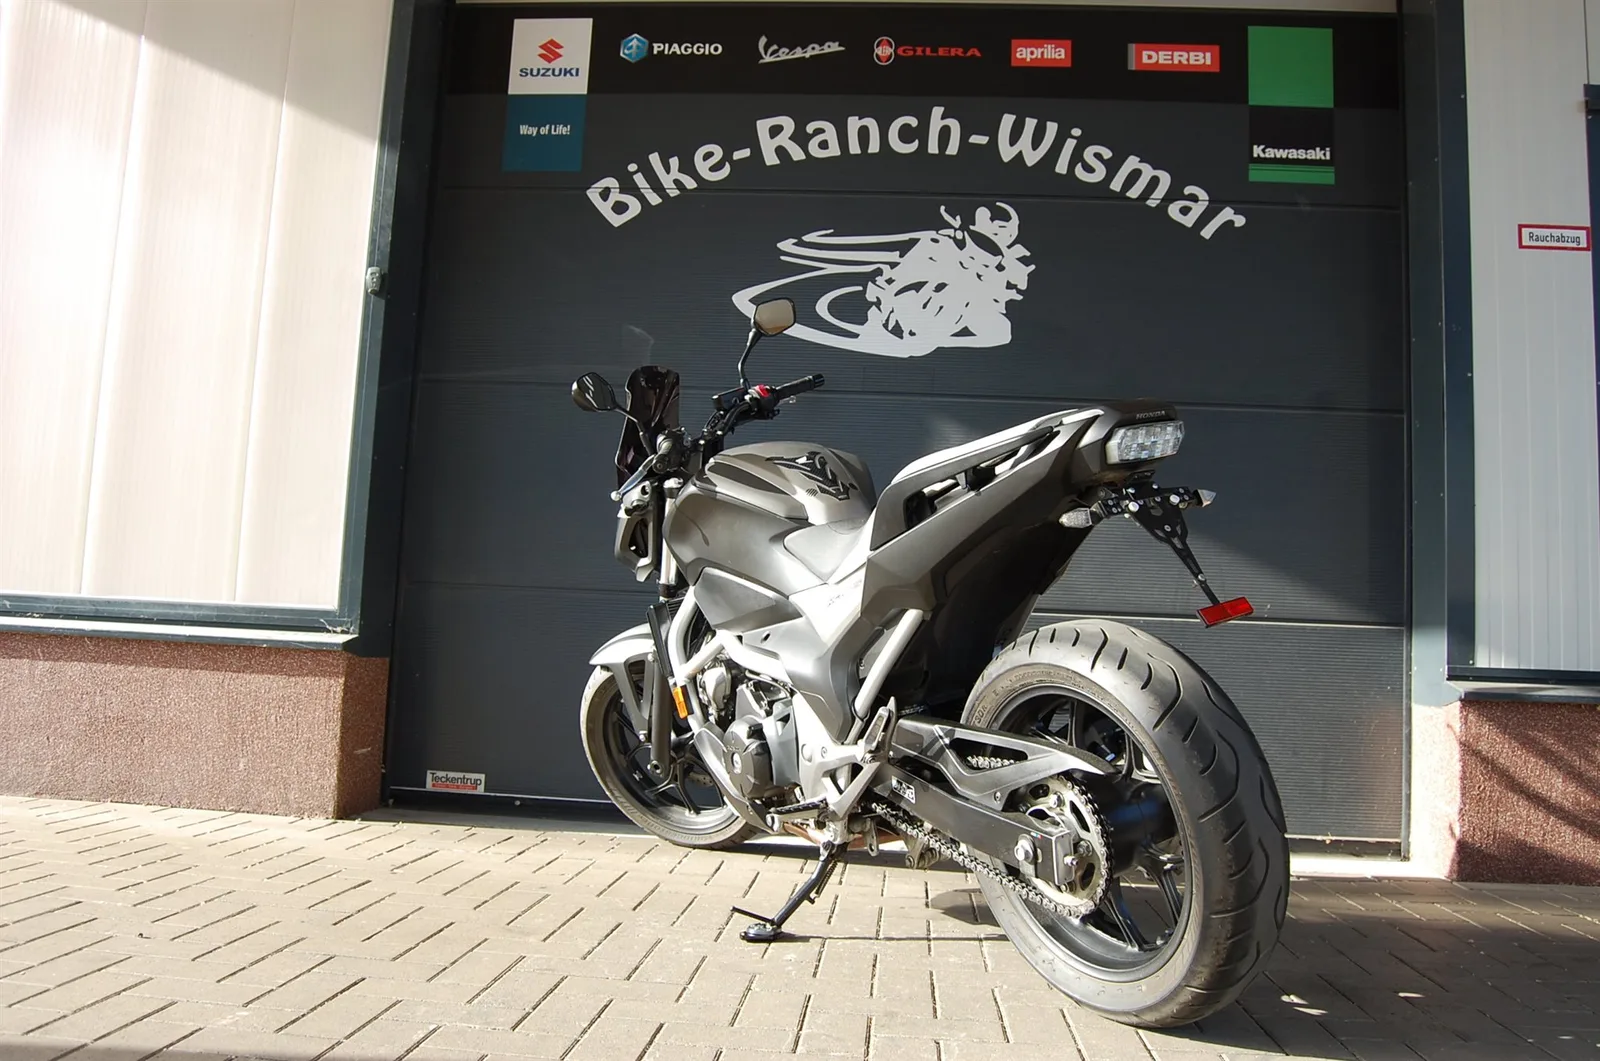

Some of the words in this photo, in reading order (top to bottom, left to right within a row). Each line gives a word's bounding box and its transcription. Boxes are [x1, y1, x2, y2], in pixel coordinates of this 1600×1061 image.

[652, 43, 723, 56] PIAGGIO
[758, 34, 846, 64] Vespa
[897, 45, 982, 57] GILERA
[1015, 43, 1066, 62] aprilia
[1141, 50, 1212, 66] DERBI
[518, 67, 581, 78] SUZUKI
[519, 124, 538, 137] Way
[539, 124, 550, 135] of
[551, 124, 571, 135] Life!
[1252, 144, 1331, 160] Kawasaki
[585, 105, 1247, 241] Bike-Ranch-Wismar
[1528, 231, 1581, 246] Rauchabzug
[1135, 410, 1166, 420] HONDA
[429, 772, 482, 790] Teckentrup
